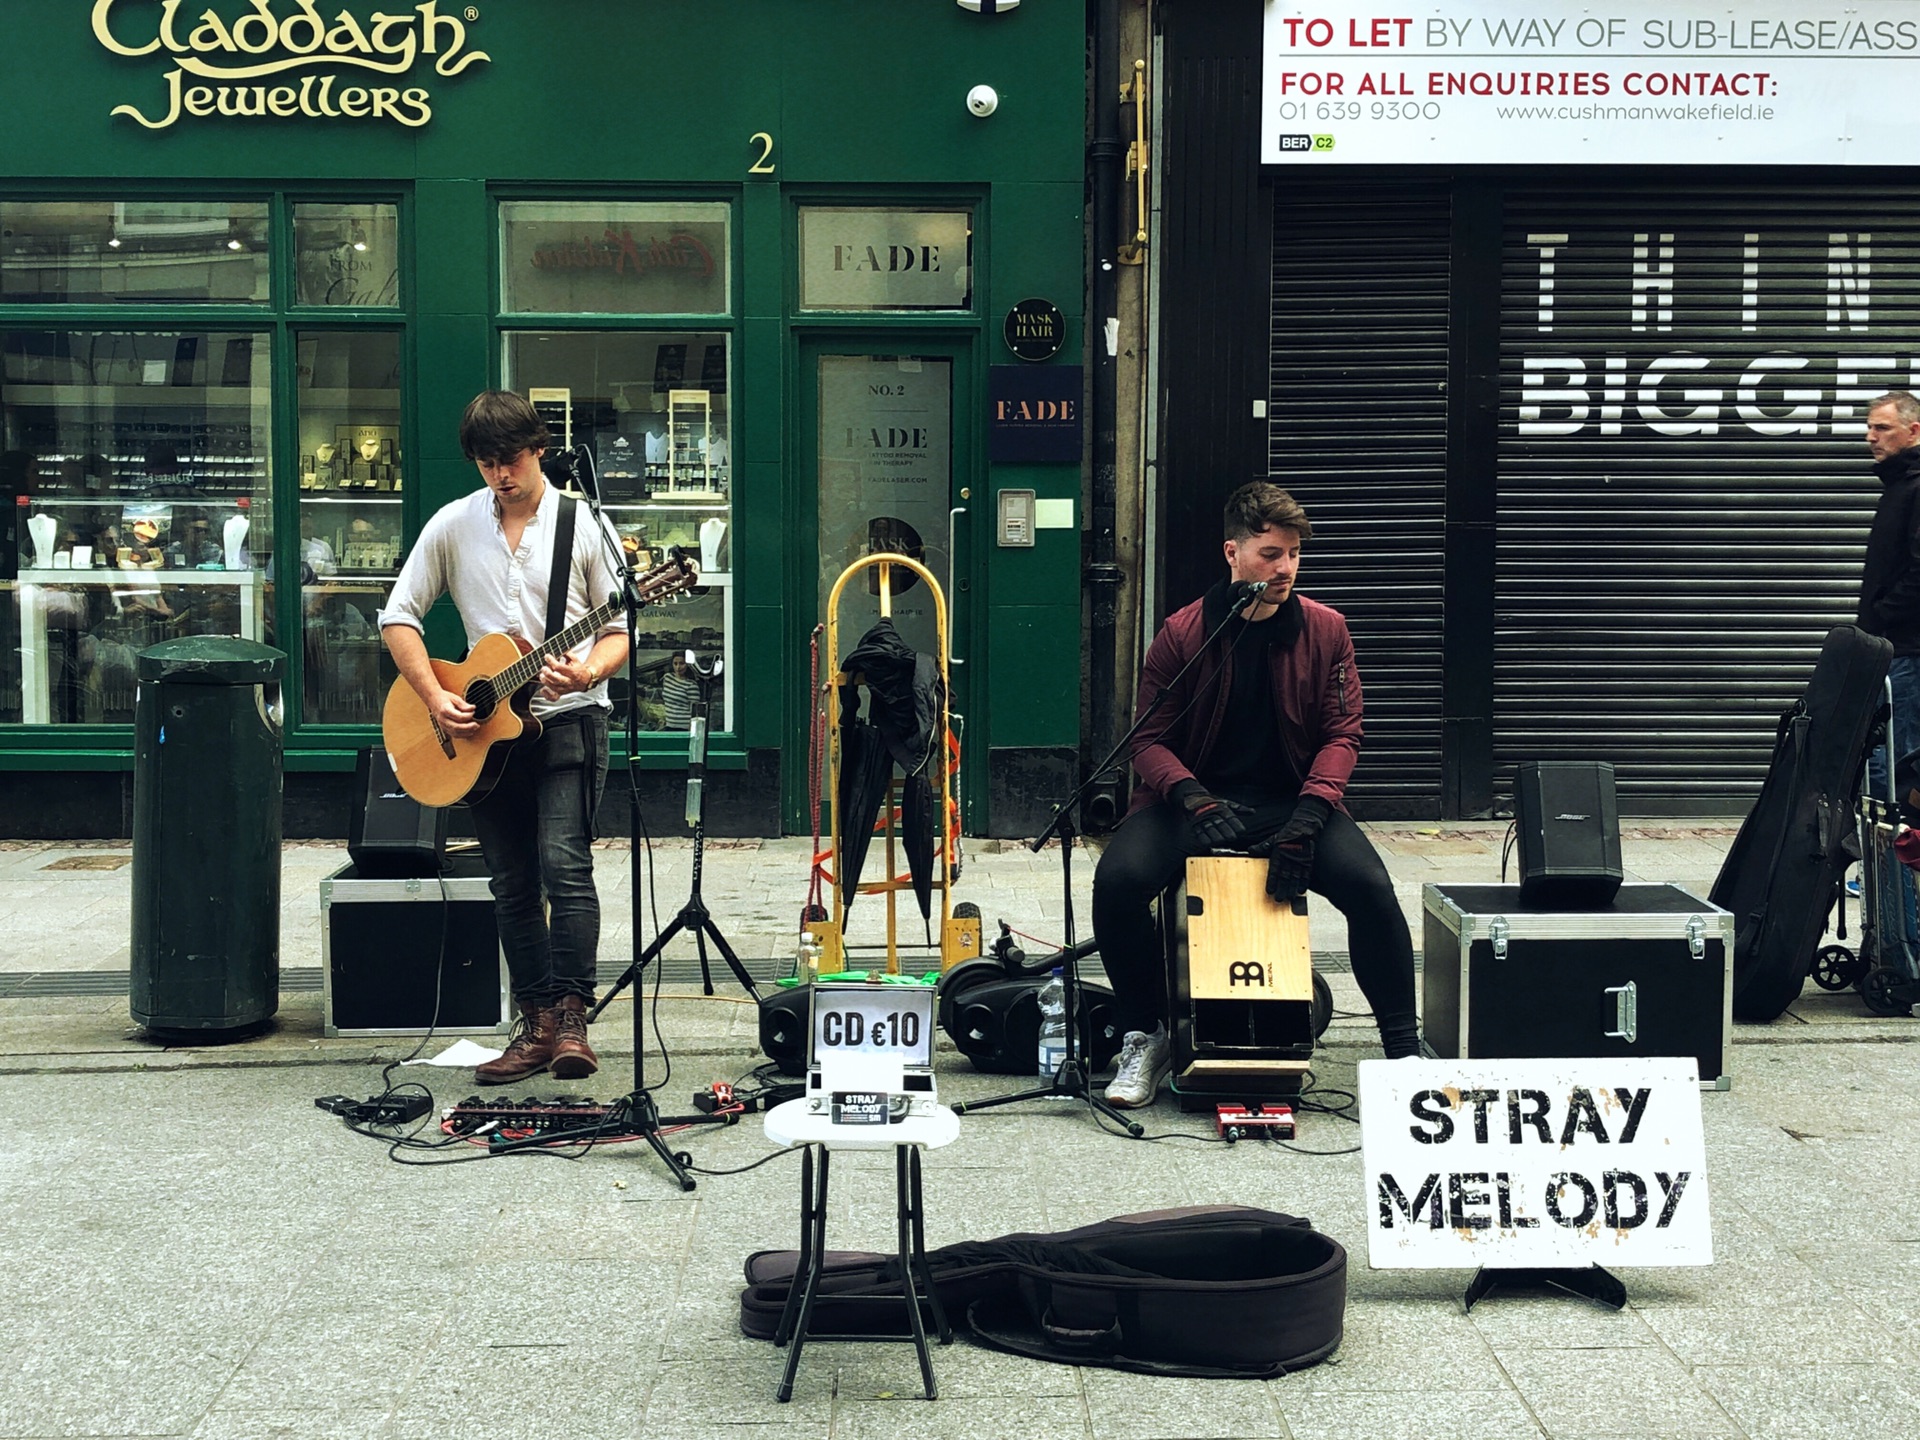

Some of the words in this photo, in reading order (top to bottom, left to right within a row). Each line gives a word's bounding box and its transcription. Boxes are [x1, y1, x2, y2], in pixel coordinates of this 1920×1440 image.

[1283, 18, 1334, 47] TO
[1349, 18, 1413, 47] LET
[1426, 18, 1472, 48] BY
[1482, 18, 1566, 48] WAY
[1576, 18, 1627, 48] OF
[1281, 72, 1344, 95] FOR
[1357, 72, 1415, 95] ALL
[1428, 72, 1611, 96] ENQUIRIES
[1623, 73, 1778, 96] CONTACT:
[1279, 101, 1307, 120] 01
[1316, 101, 1362, 120] 639
[1370, 101, 1441, 120] 9300
[1496, 103, 1775, 120] www.cushmanwakefield.ie
[747, 132, 776, 174] 2
[1281, 137, 1309, 149] BER
[1315, 137, 1333, 149] C2
[833, 245, 941, 273] FADE
[1017, 313, 1054, 324] MASK
[1016, 325, 1054, 337] HAIR
[867, 385, 894, 396] NO.
[897, 385, 905, 396] 2
[997, 400, 1075, 420] FADE
[846, 428, 928, 449] FADE
[823, 1011, 864, 1046] CD
[871, 1011, 919, 1047] €10
[840, 1104, 881, 1113] MELODY
[845, 1095, 877, 1104] STRAY
[1409, 1087, 1653, 1145] STRAY
[1377, 1169, 1693, 1230] MELODY
